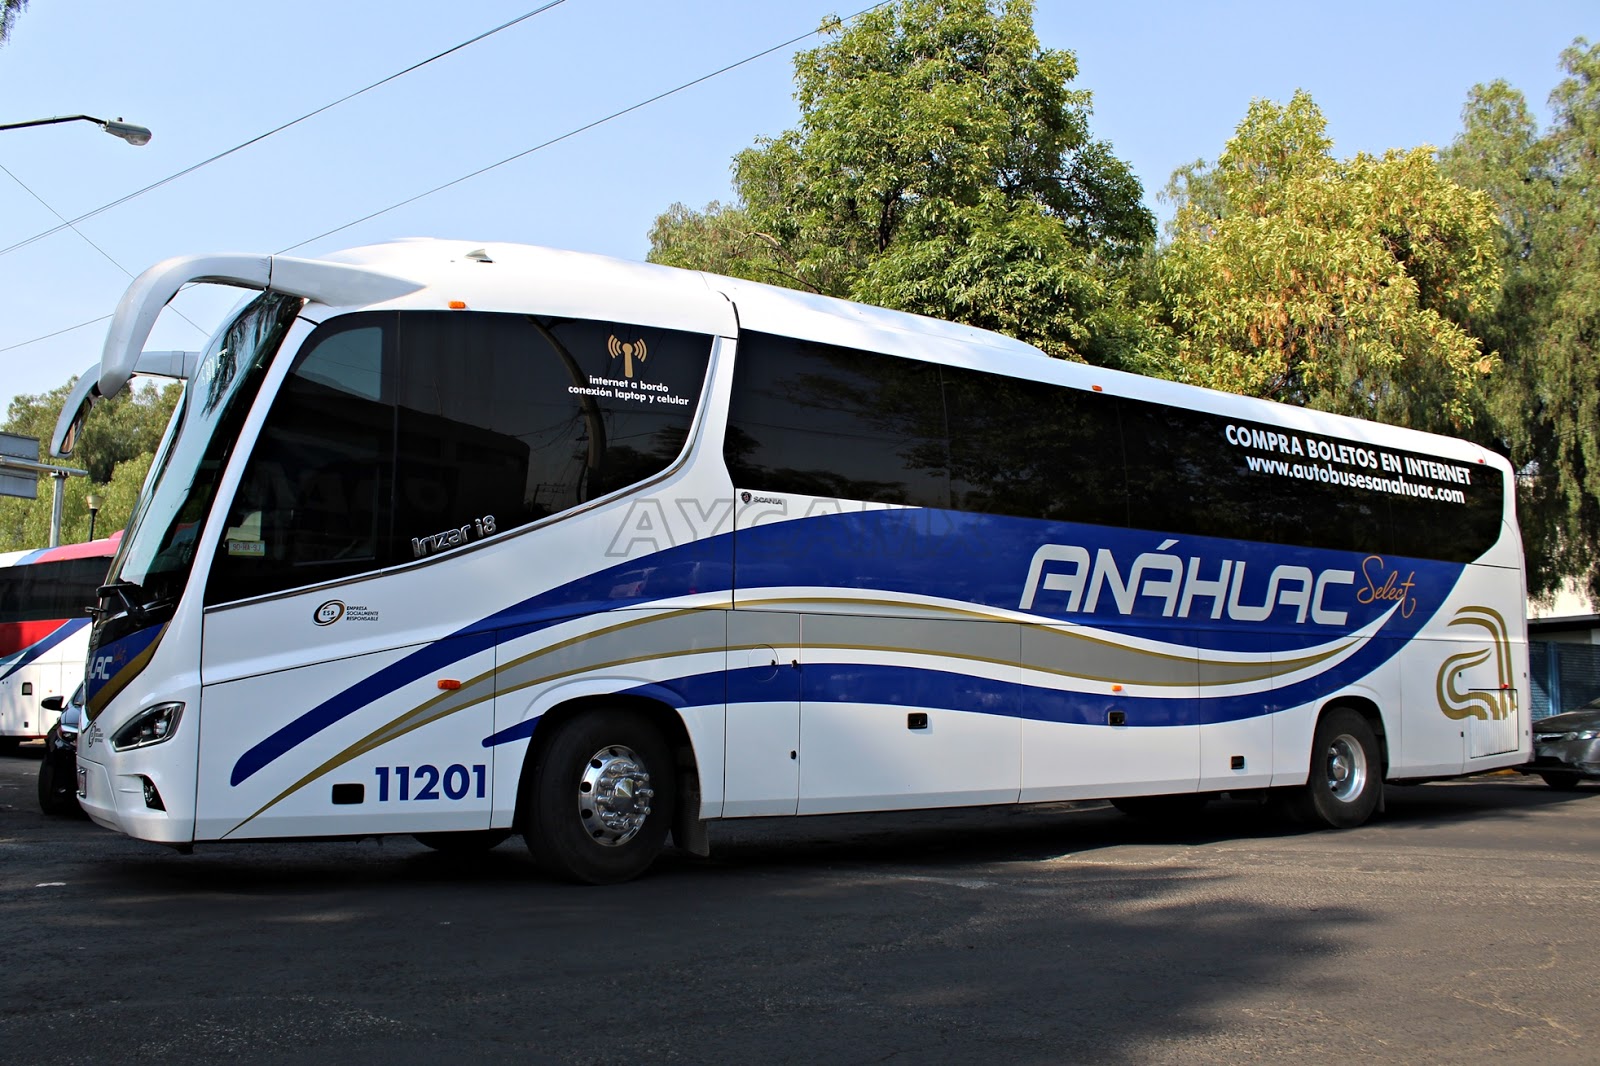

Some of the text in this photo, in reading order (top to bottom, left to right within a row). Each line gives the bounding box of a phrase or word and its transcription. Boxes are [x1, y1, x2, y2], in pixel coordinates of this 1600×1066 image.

[568, 386, 689, 405] conexión laptop y celular
[589, 375, 669, 392] internet a bordo
[1225, 424, 1472, 486] COMPRA BOLETOS EN INTERNET
[1246, 455, 1466, 504] www.autobusesanahuac.com
[753, 496, 783, 505] SCANIA
[412, 514, 497, 558] Irizar i8
[1018, 539, 1417, 626] ANÁHUAC Select
[375, 763, 486, 802] 11201
